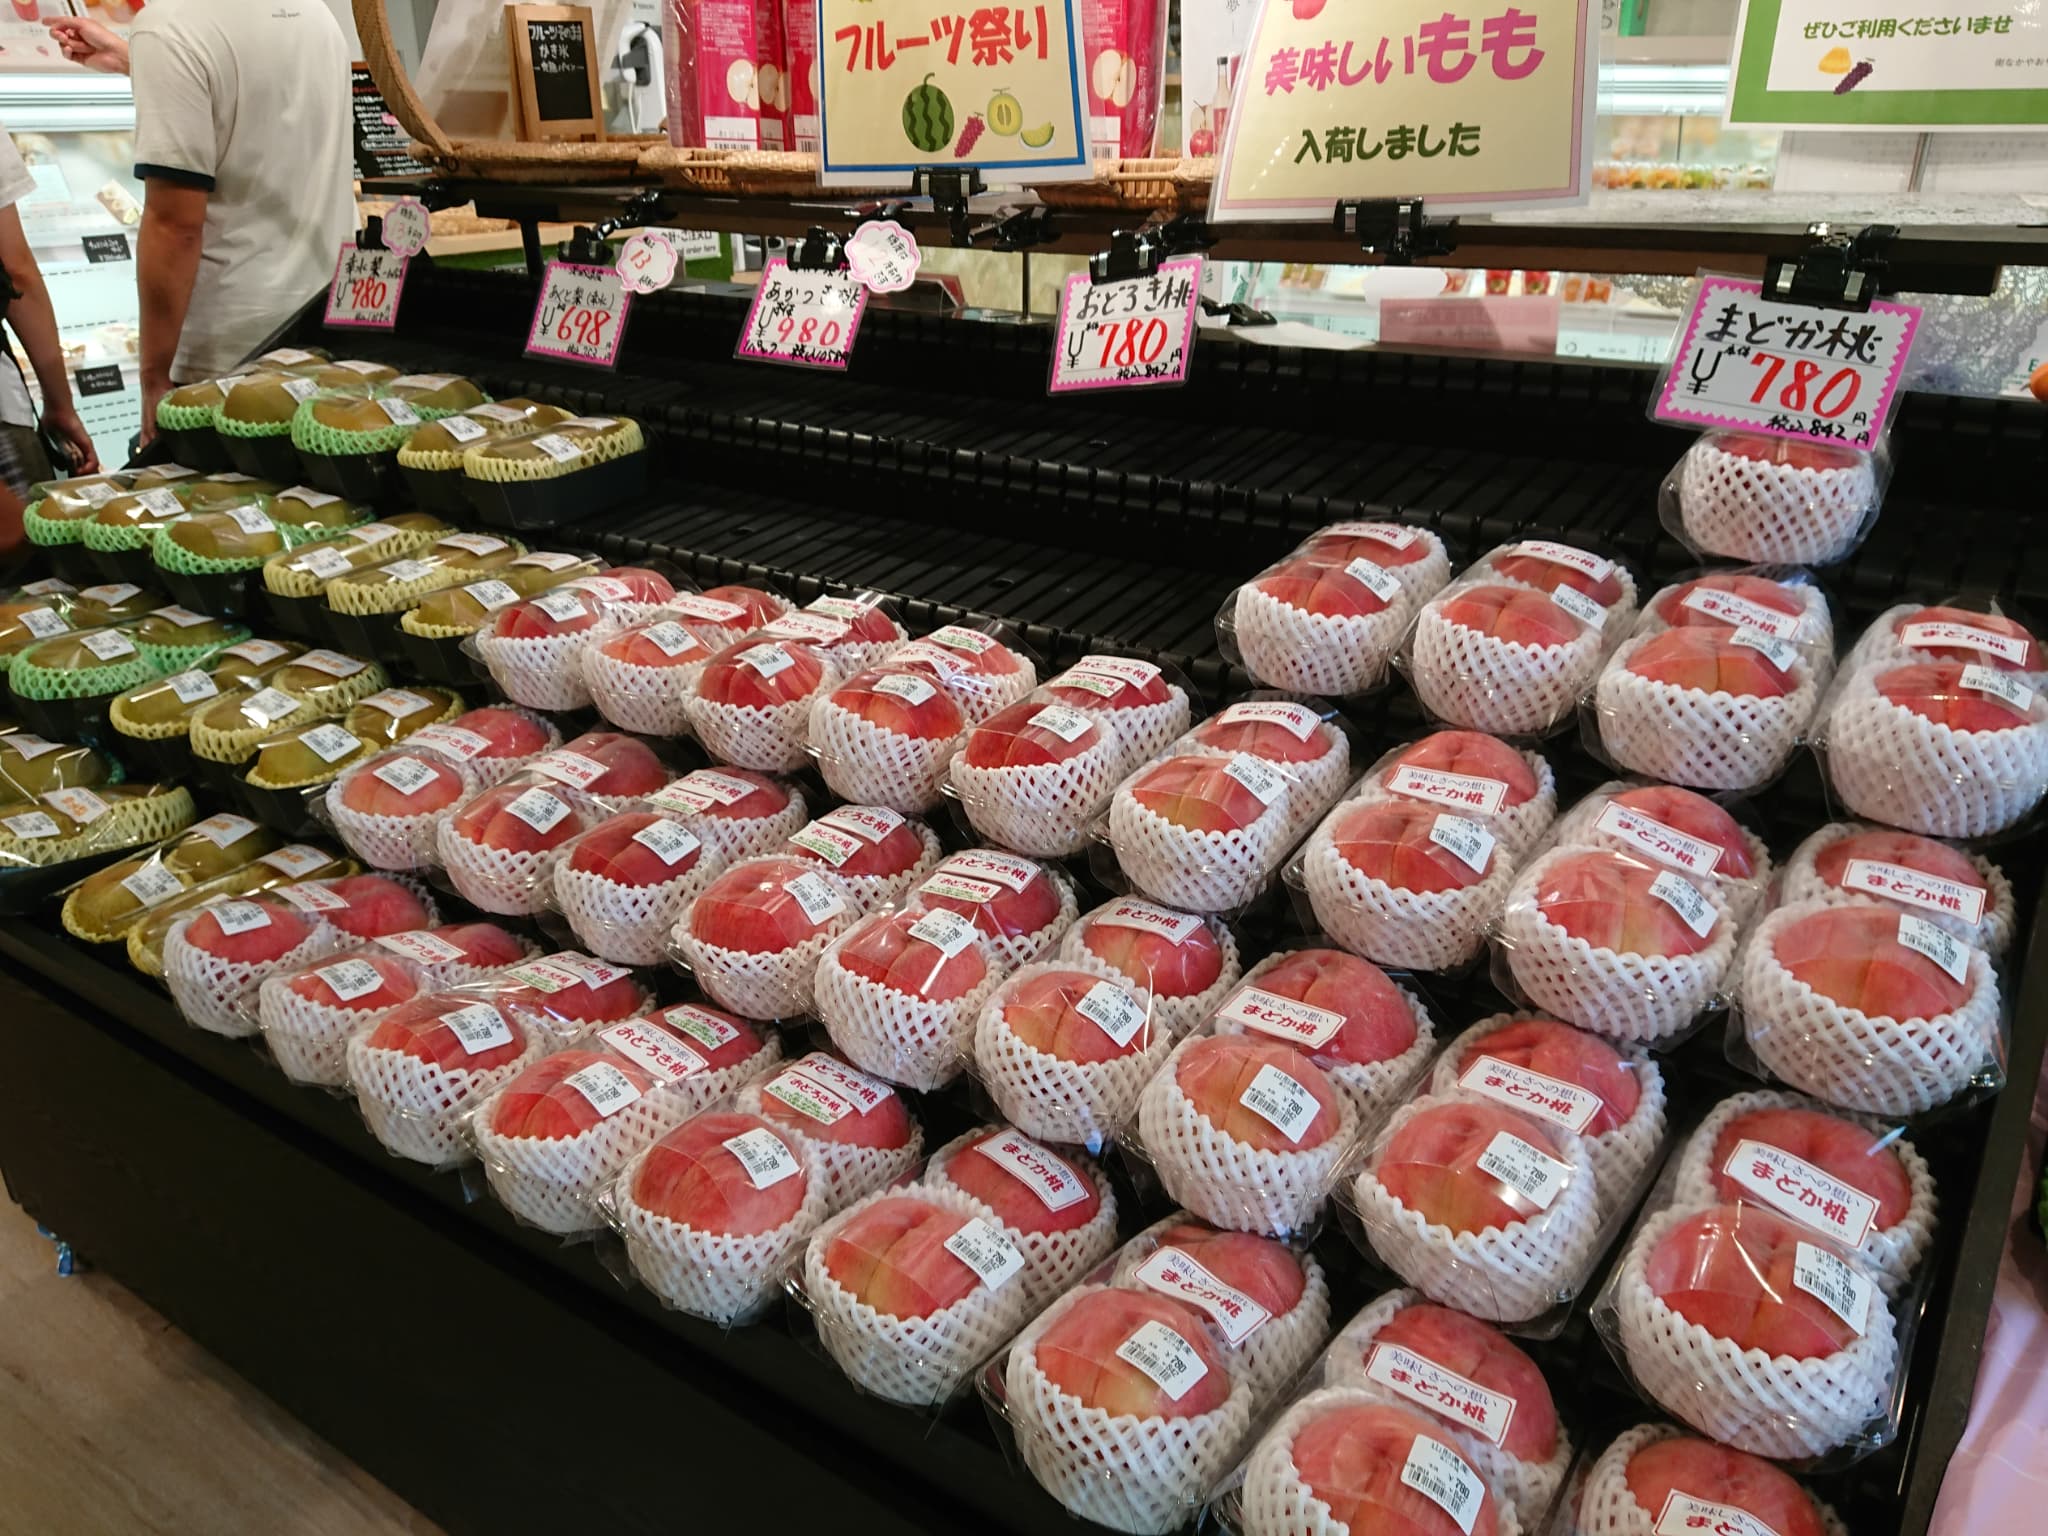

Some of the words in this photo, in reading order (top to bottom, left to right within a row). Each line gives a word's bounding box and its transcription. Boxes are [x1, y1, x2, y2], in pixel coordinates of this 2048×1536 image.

[834, 4, 1049, 73] フルーツ祭り
[1802, 15, 2014, 40] ぜひご利用くださいませ
[1264, 7, 1545, 97] 美味しいもも
[1293, 121, 1481, 166] 入荷しました
[630, 249, 652, 270] 13
[351, 276, 387, 310] 980
[1076, 275, 1194, 320] おどろき桃
[540, 305, 556, 335] ¥
[557, 305, 611, 346] 698
[755, 306, 774, 339] ¥
[777, 315, 841, 347] 980
[1067, 331, 1085, 369] ¥
[1098, 317, 1168, 368] 780
[1705, 303, 1883, 364] まどか桃
[1686, 347, 1723, 395] ¥
[1750, 351, 1863, 419] 780
[1702, 599, 1778, 636] まどか桃
[1236, 708, 1304, 726] まどか桃
[1407, 781, 1485, 805] まどか桃
[1469, 836, 1482, 850] 780
[1617, 819, 1696, 868] まどか桃
[949, 857, 1028, 882] おどろき桃
[1867, 874, 1962, 911] まどか桃
[1115, 907, 1180, 930] まどか桃
[684, 1010, 729, 1035] おどろき桃
[1242, 1004, 1318, 1036] まどか桃
[1250, 993, 1329, 1023] 美味しさへの想い
[617, 1026, 689, 1077] おどろき桃
[637, 1023, 696, 1064] 美味しさへの想い
[789, 1078, 841, 1112] おどろき桃
[803, 1058, 877, 1104] おどろき桃
[1484, 1076, 1574, 1115] まどか桃
[1488, 1063, 1586, 1102] 美味しさへの想い
[1289, 1100, 1303, 1116] 780
[1002, 1142, 1065, 1194] まどか桃
[1529, 1166, 1547, 1182] 780
[1753, 1147, 1860, 1207] 美味しさへの想い
[1751, 1160, 1850, 1226] まどか桃
[992, 1251, 1007, 1266] 780
[1160, 1268, 1243, 1319] まどか桃
[1168, 1253, 1255, 1311] 美味しさへの想い
[1841, 1285, 1856, 1301] 780
[1171, 1355, 1187, 1373] 780
[1390, 1349, 1498, 1407] 美味しさへの想い
[1390, 1367, 1488, 1425] まどか桃
[1456, 1478, 1470, 1499] 780
